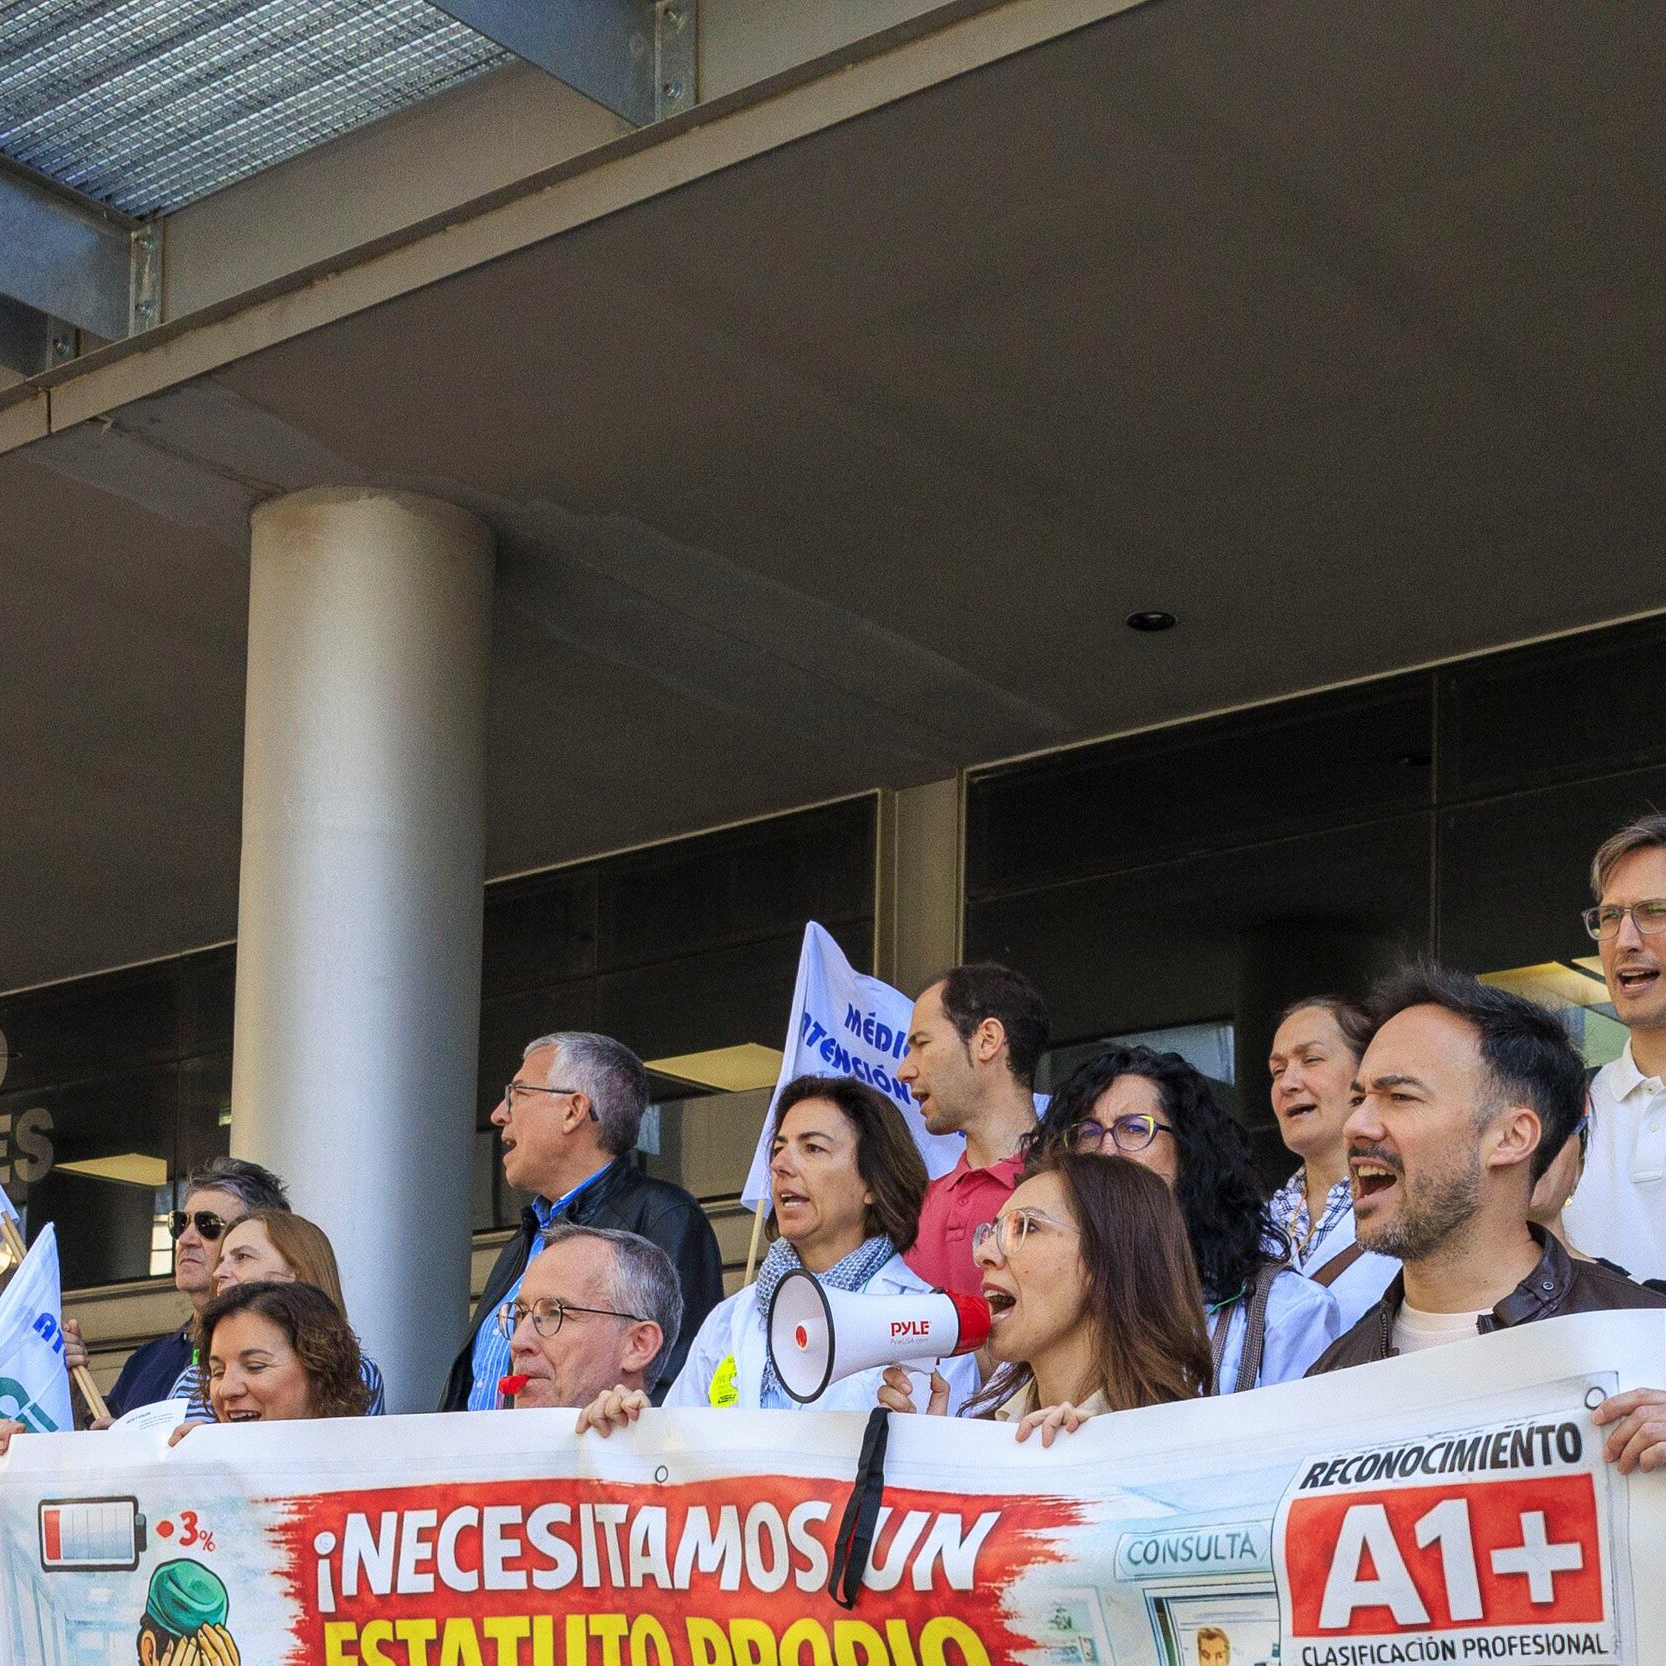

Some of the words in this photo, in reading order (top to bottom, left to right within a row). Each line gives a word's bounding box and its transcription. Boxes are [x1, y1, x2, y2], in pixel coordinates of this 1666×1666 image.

[844, 1003, 910, 1060] MÉDI
[891, 1320, 930, 1336] PYLE
[1300, 1423, 1583, 1489] RECONOCIMIENTO
[311, 1498, 832, 1614] ¡NECESITAMOS
[863, 1507, 1002, 1591] UN
[1126, 1531, 1257, 1568] CONSULTA
[1318, 1498, 1583, 1630] A1+
[1462, 1632, 1609, 1662] PROFESIONAL
